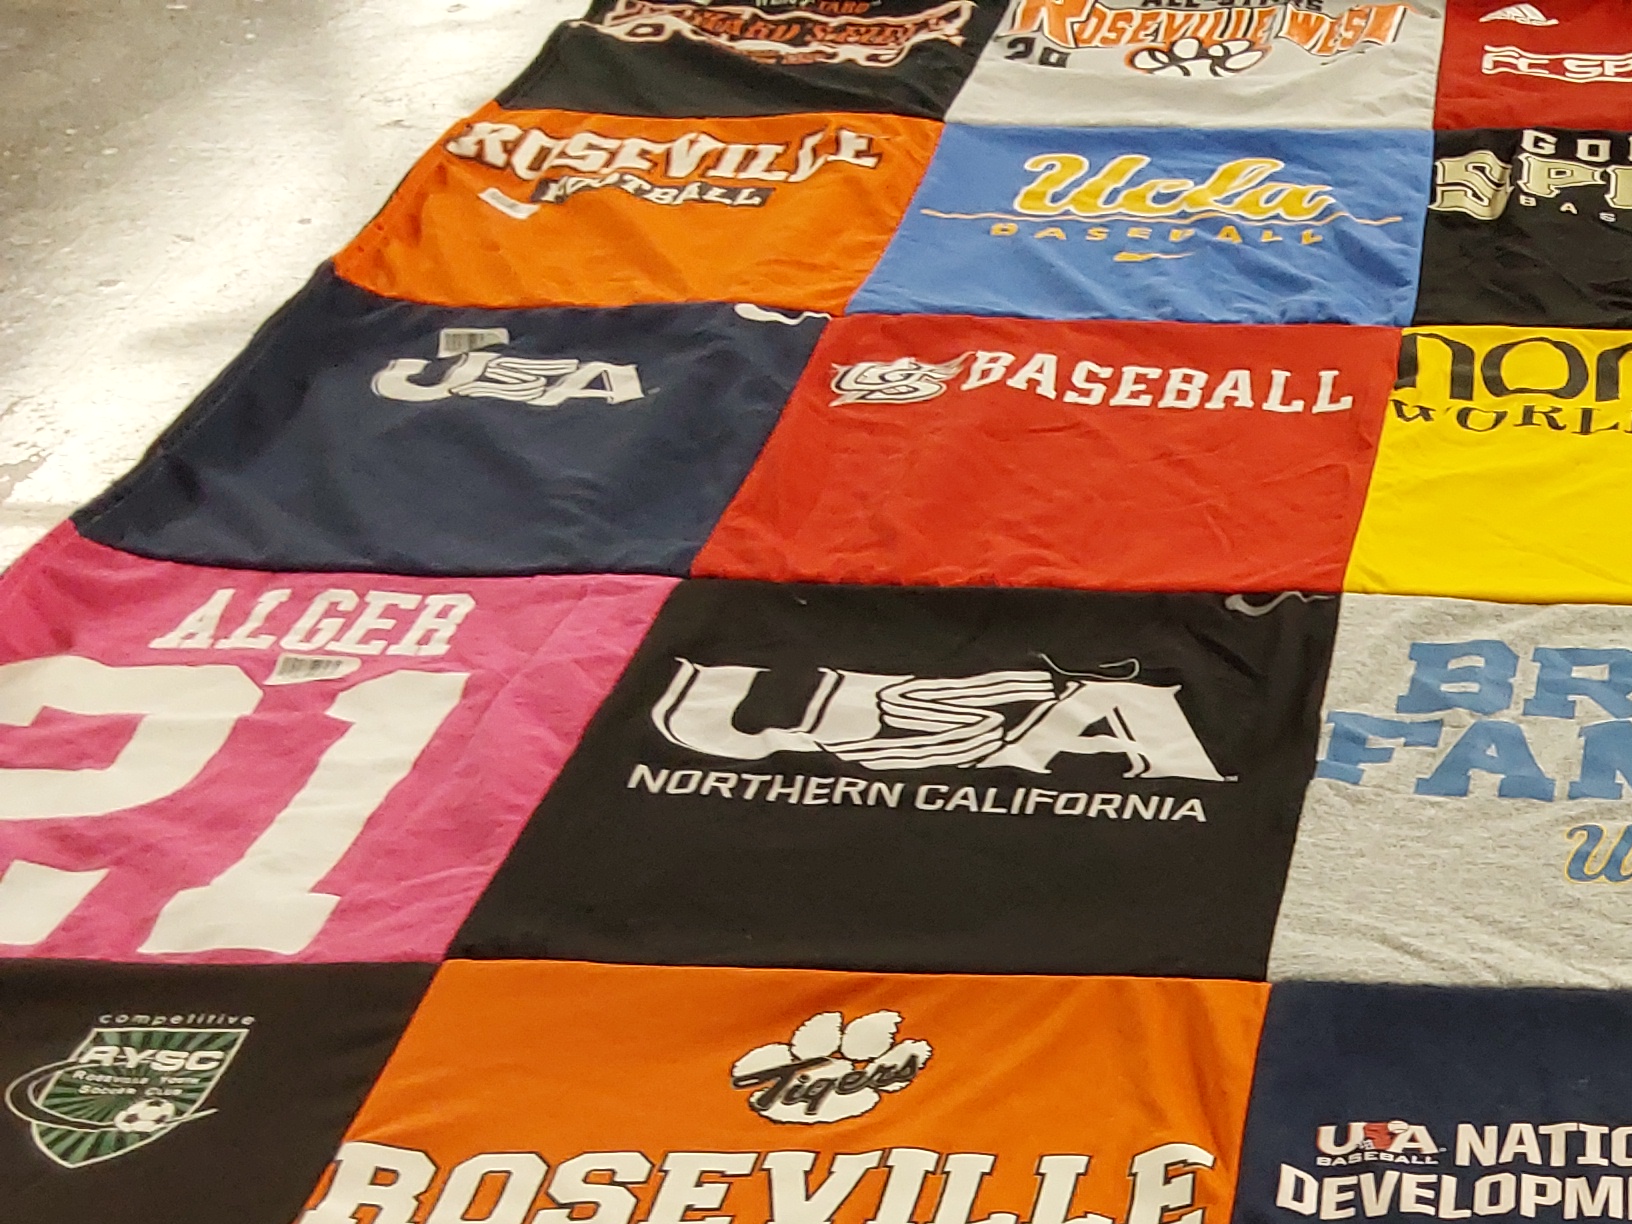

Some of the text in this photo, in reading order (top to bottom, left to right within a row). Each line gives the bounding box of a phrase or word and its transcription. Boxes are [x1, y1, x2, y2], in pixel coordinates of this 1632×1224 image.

[1008, 0, 1278, 48] ROSEVILLE
[1483, 51, 1550, 75] FC
[445, 122, 883, 183] ROSEVILLE
[541, 173, 764, 206] FOOTBALL
[1014, 153, 1338, 221] Ucla
[990, 223, 1324, 245] BASEBALL
[960, 350, 1353, 413] BASEBALL
[149, 588, 476, 656] ALGER
[651, 656, 1228, 783] USA
[0, 655, 470, 955] 21
[627, 764, 1207, 823] NORTHERN CALIFORNIA
[98, 1012, 256, 1026] competitive
[78, 1045, 226, 1072] RYSC
[731, 1054, 920, 1116] Tigers
[1316, 1120, 1440, 1156] USA
[1316, 1151, 1440, 1167] BASEBALL
